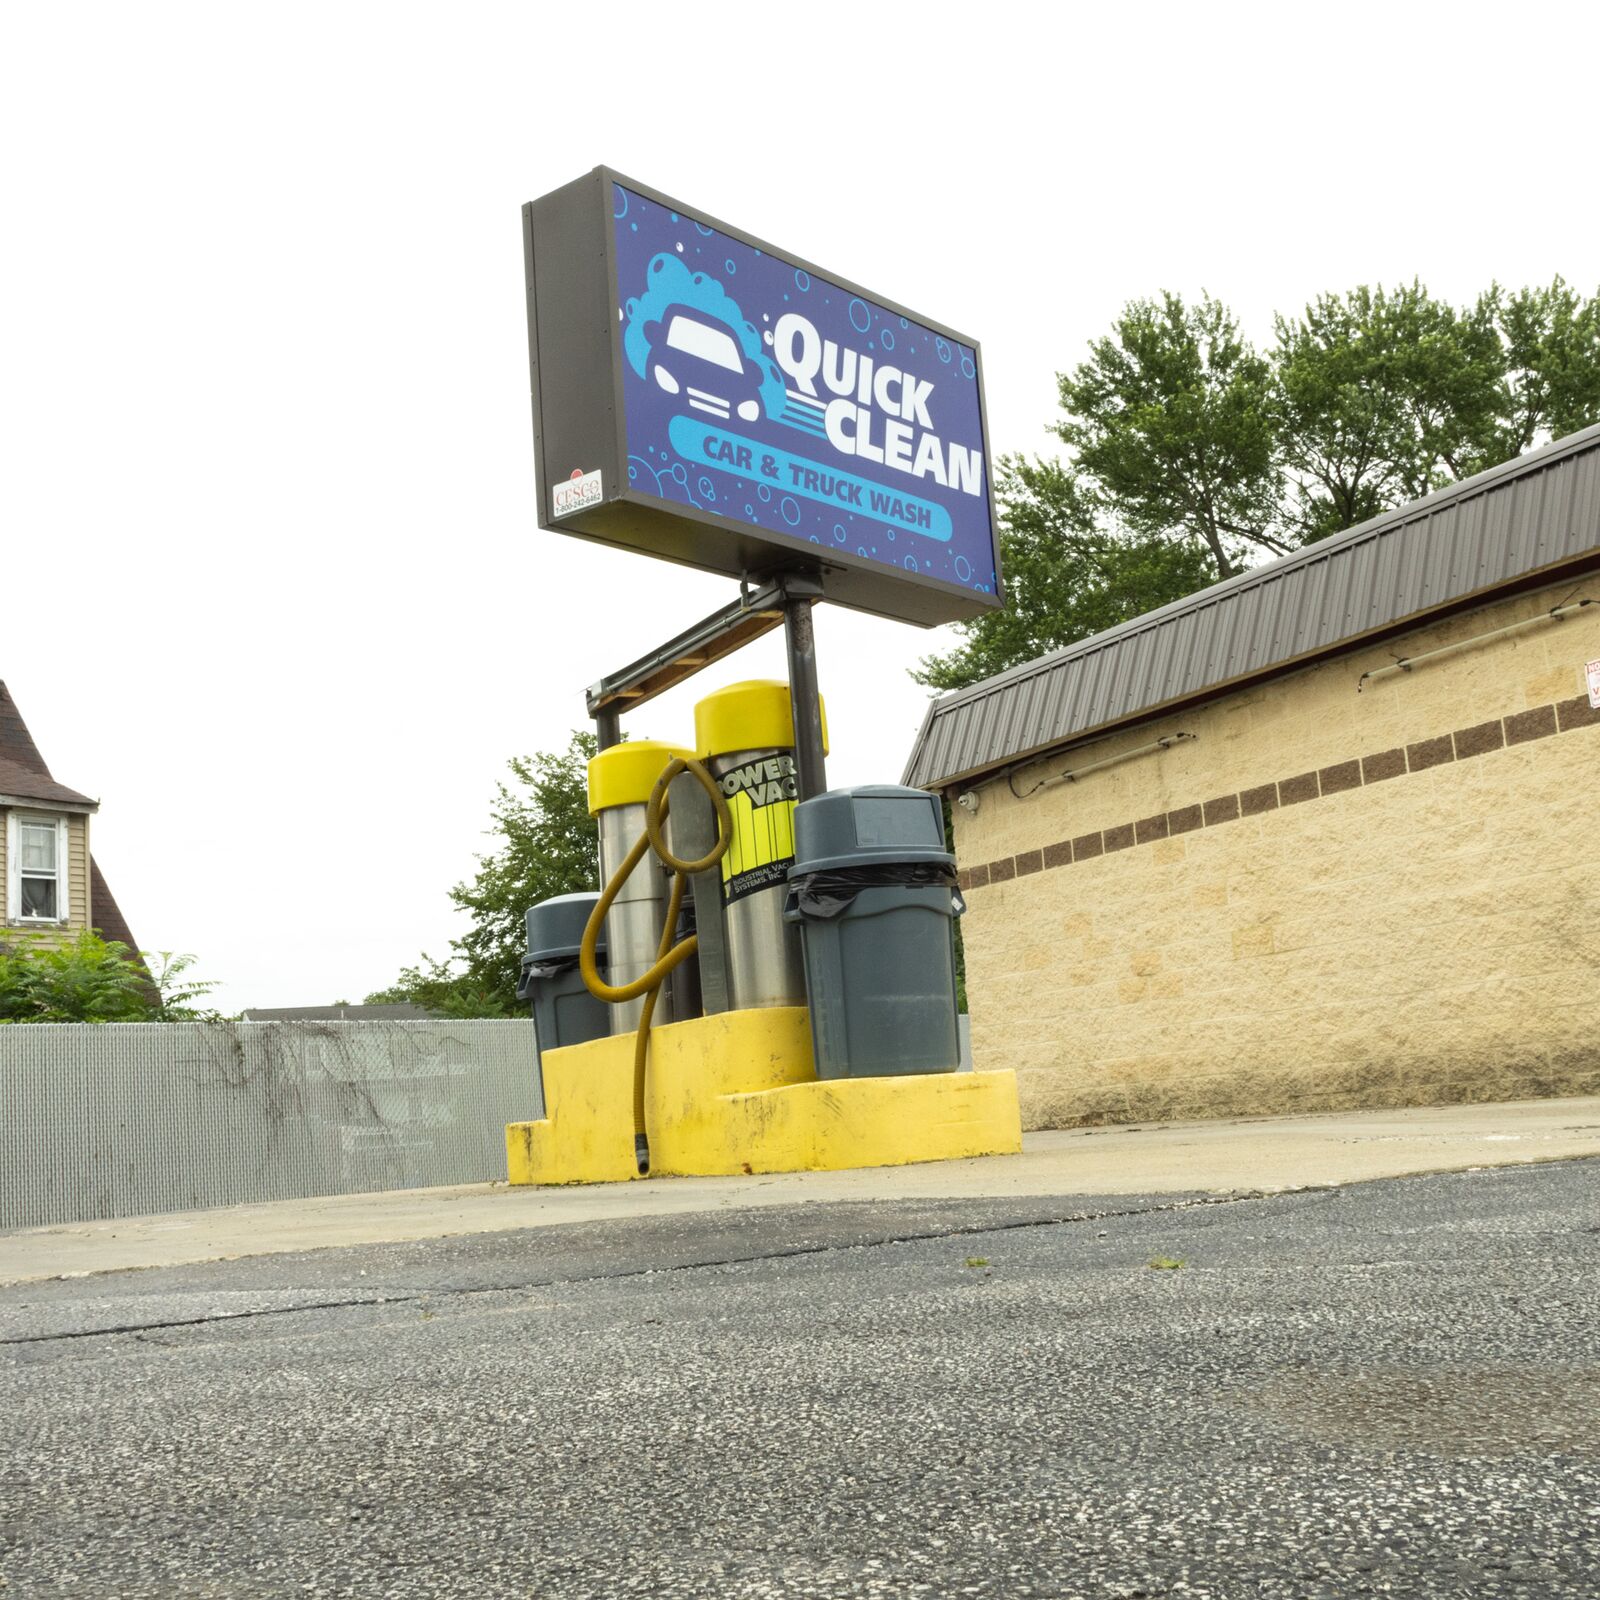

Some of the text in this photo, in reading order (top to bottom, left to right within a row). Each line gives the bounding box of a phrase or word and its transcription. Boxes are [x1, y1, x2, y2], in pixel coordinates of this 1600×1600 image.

[774, 313, 935, 430] QUICK
[703, 435, 931, 530] CAR & TRUCK WASH
[824, 398, 982, 497] CLEAN
[746, 777, 798, 807] VAC
[733, 868, 772, 886] INDUSTRIAL
